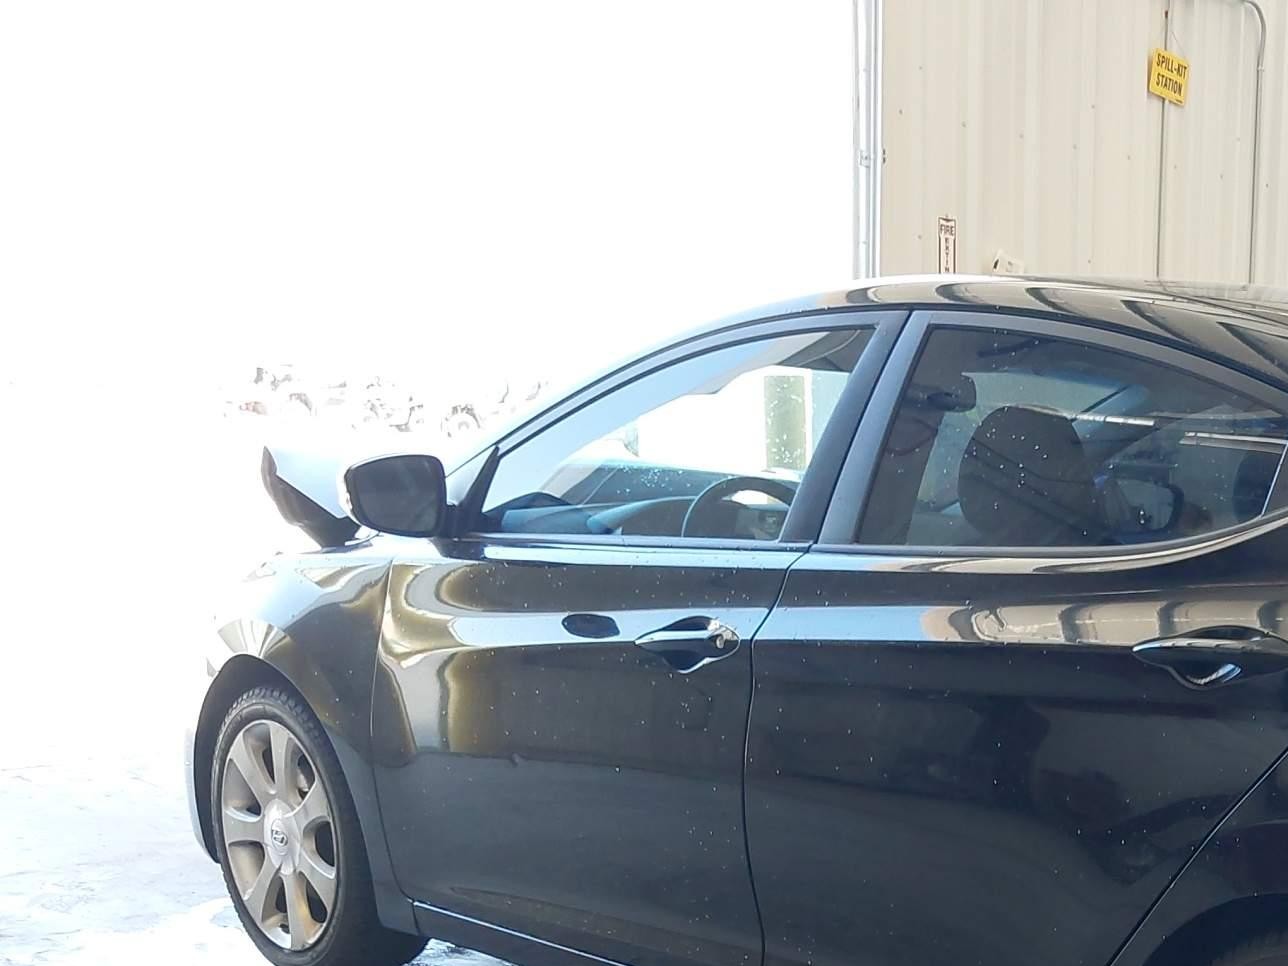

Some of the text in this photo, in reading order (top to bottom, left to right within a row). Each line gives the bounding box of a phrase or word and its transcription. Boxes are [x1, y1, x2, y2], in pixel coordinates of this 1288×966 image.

[1156, 53, 1188, 79] SPILL-KIT
[1156, 72, 1183, 96] STATION
[940, 223, 955, 236] FIRE
